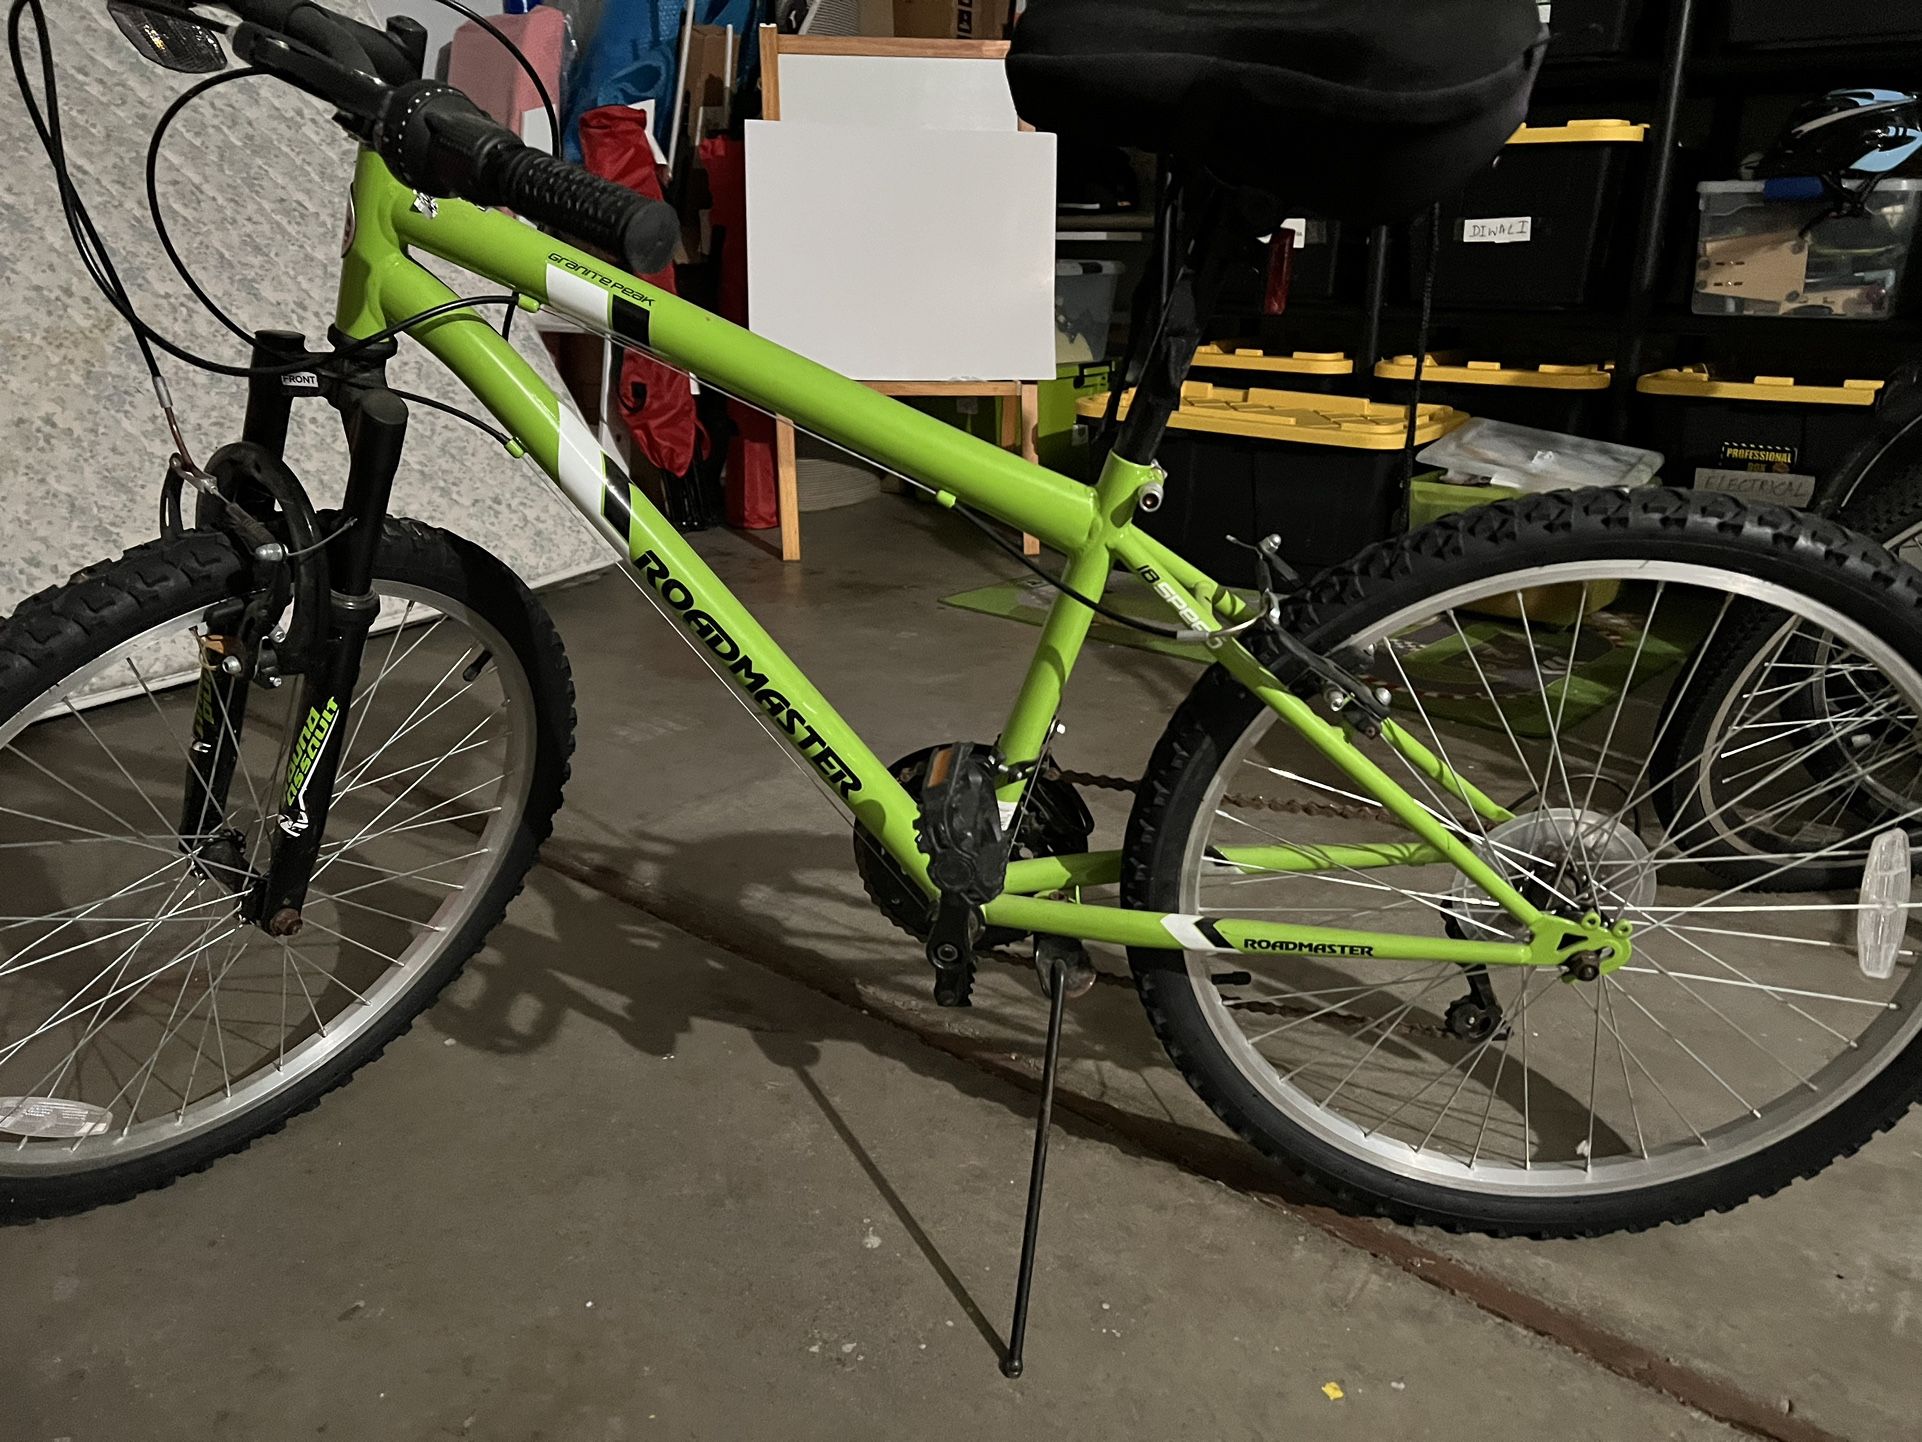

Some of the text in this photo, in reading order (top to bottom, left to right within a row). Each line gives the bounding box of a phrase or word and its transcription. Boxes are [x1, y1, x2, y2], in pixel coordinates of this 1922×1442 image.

[1469, 220, 1529, 237] DIWALI
[283, 375, 315, 384] FRONT
[1726, 447, 1792, 463] PROFESSIONAL
[633, 549, 863, 801] ROADMASTER
[1244, 938, 1373, 957] ROADMASTER
